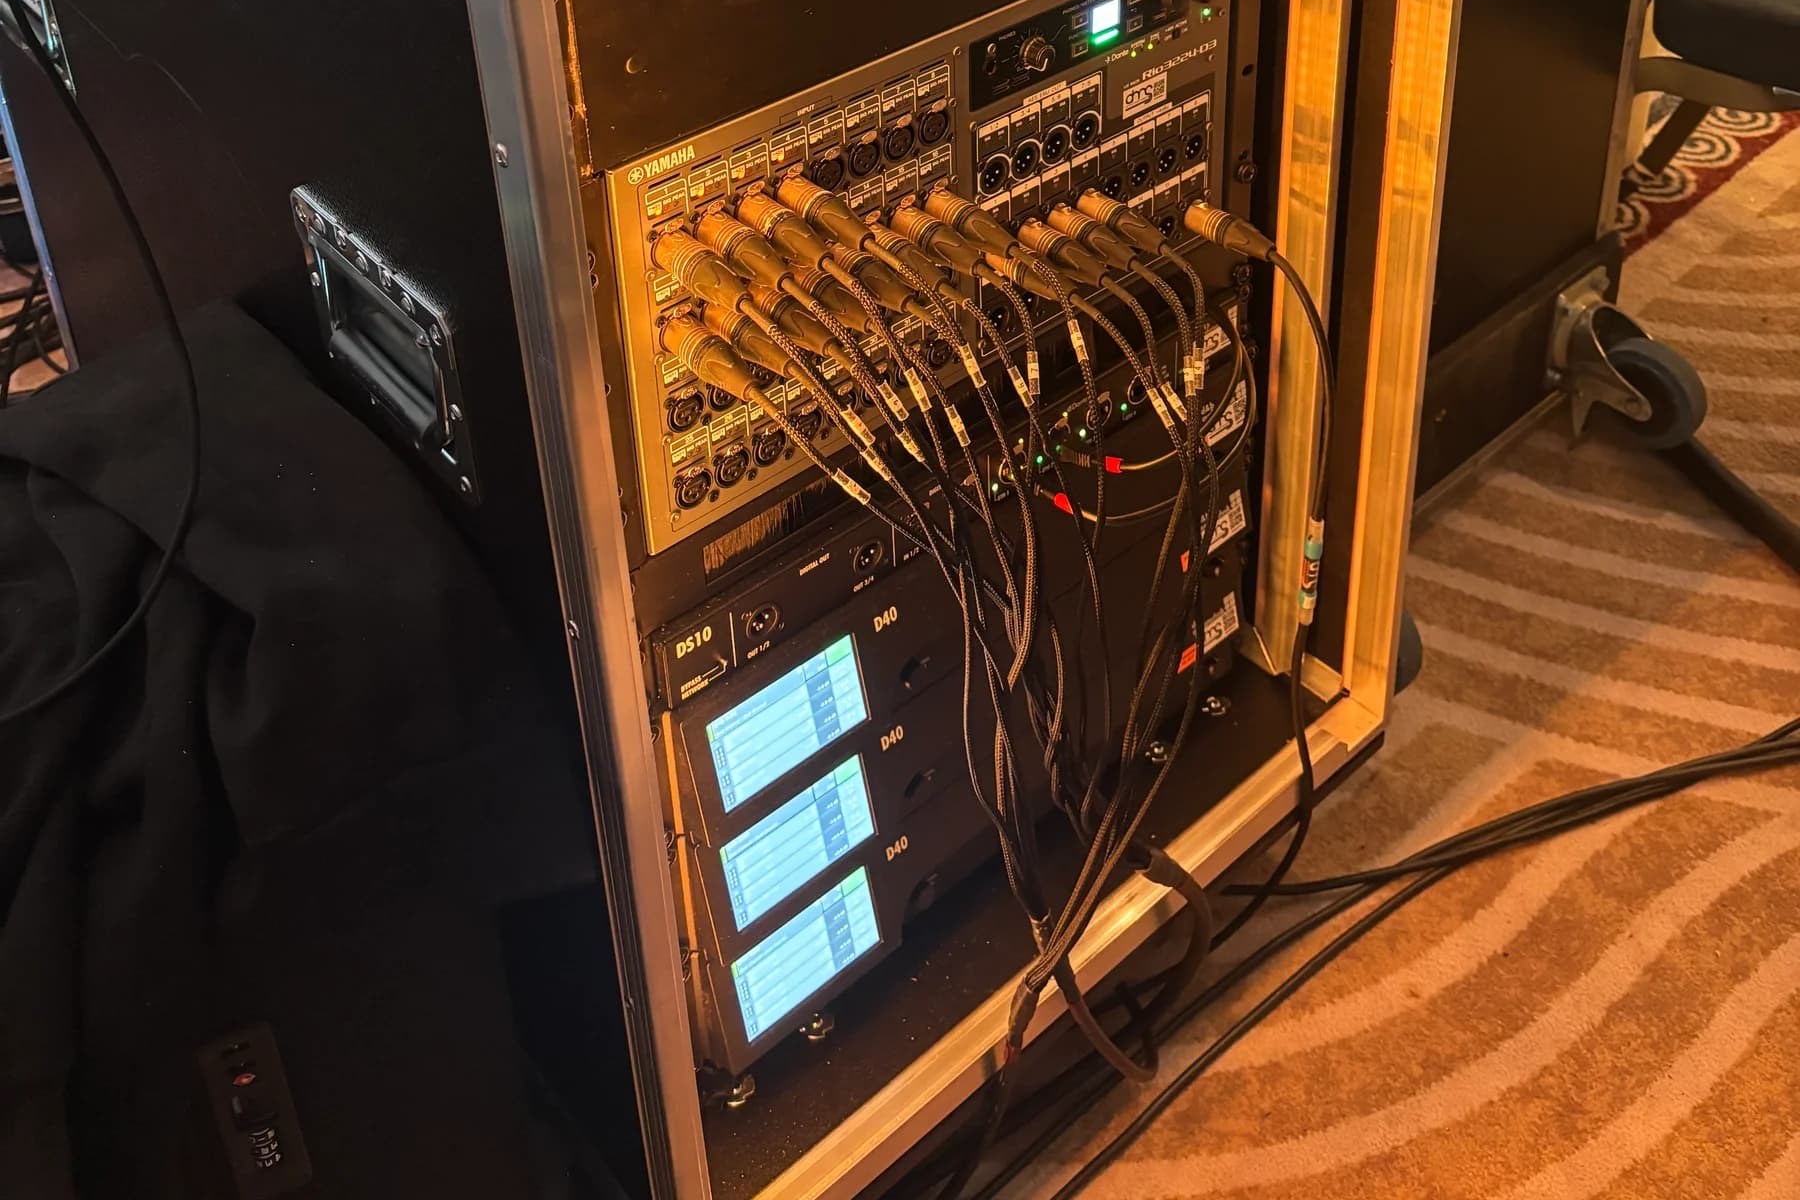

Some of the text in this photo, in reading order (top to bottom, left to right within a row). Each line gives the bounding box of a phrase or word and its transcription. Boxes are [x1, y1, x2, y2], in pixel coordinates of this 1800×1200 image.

[1112, 49, 1129, 61] Dante
[1126, 84, 1153, 105] dms
[797, 104, 815, 116] INPUT
[644, 145, 695, 178] YAMAHA
[873, 606, 897, 633] D40
[676, 626, 712, 659] DS10
[747, 641, 770, 659] OUT 1/2
[681, 675, 702, 693] BYPASS
[681, 679, 709, 700] NETWORK
[880, 725, 904, 753] D40
[885, 835, 909, 862] D40
